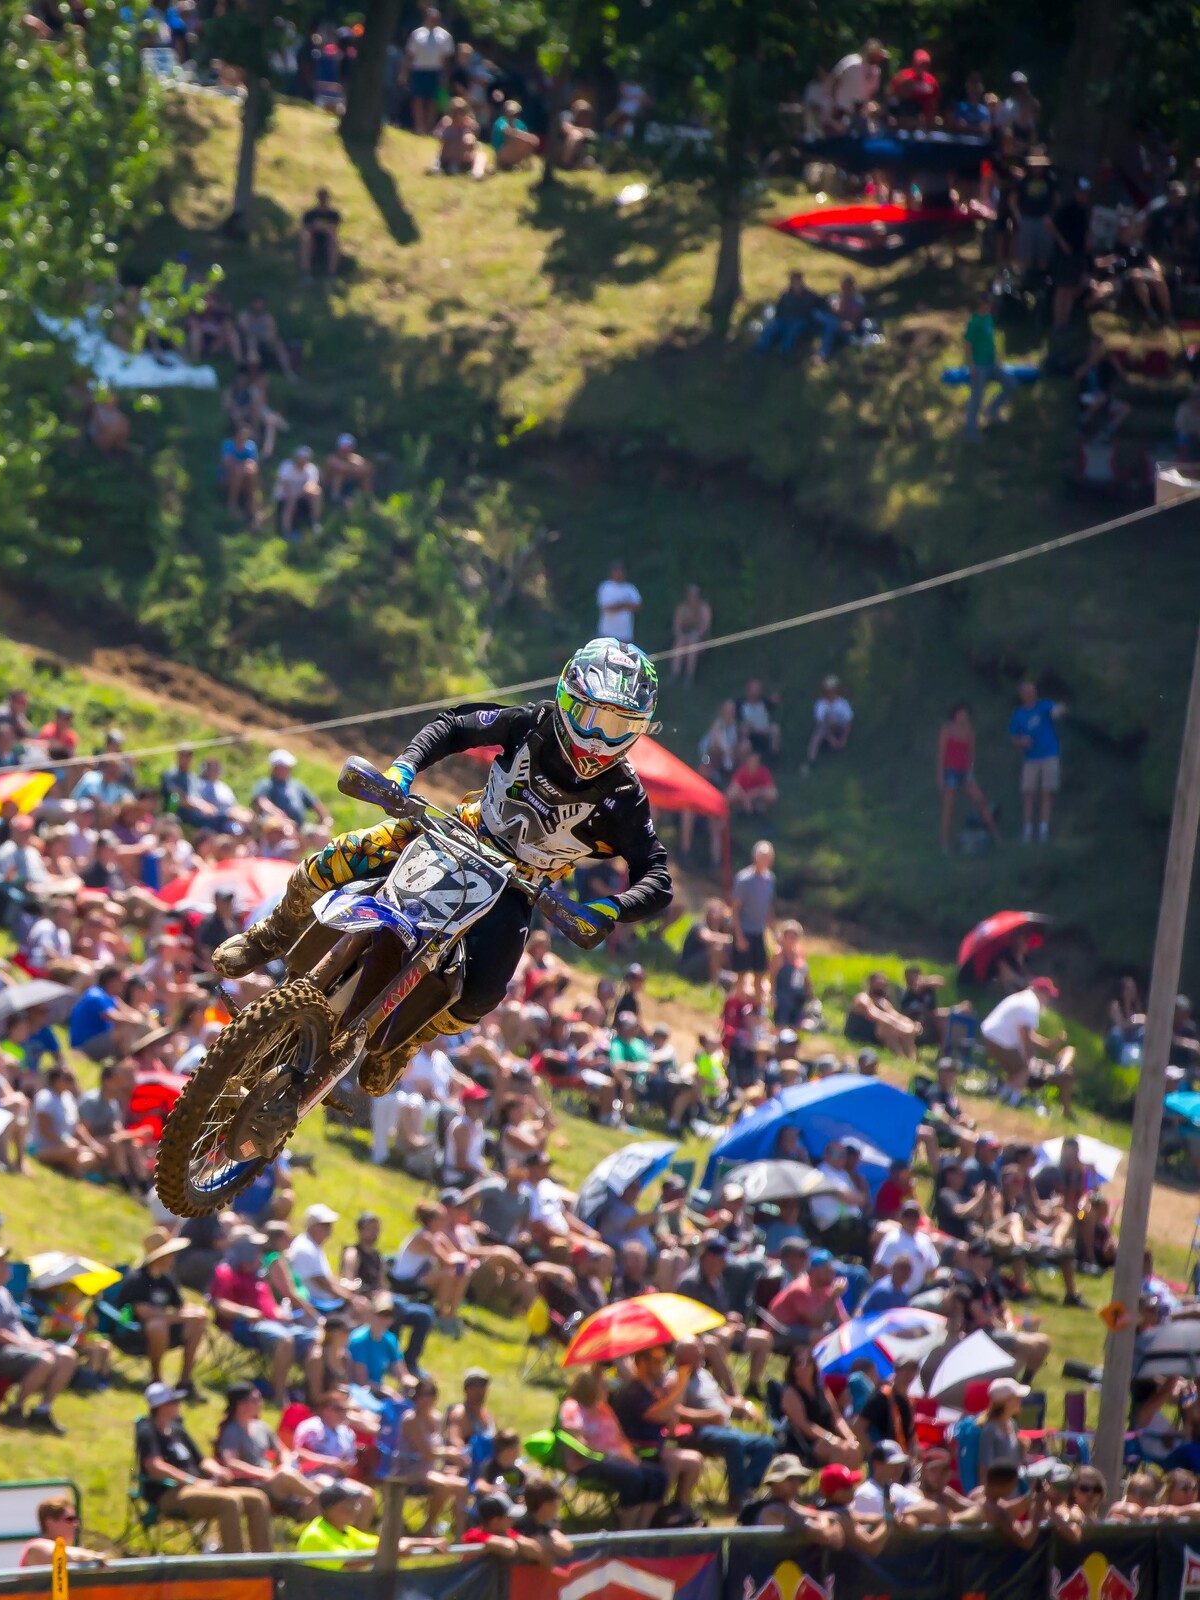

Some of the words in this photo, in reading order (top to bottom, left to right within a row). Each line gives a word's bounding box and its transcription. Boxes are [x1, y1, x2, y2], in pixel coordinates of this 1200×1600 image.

[534, 774, 563, 798] thor
[527, 794, 550, 817] YAMAHA
[467, 859, 483, 871] OIL
[393, 849, 493, 921] 62
[381, 966, 422, 1017] KYB
